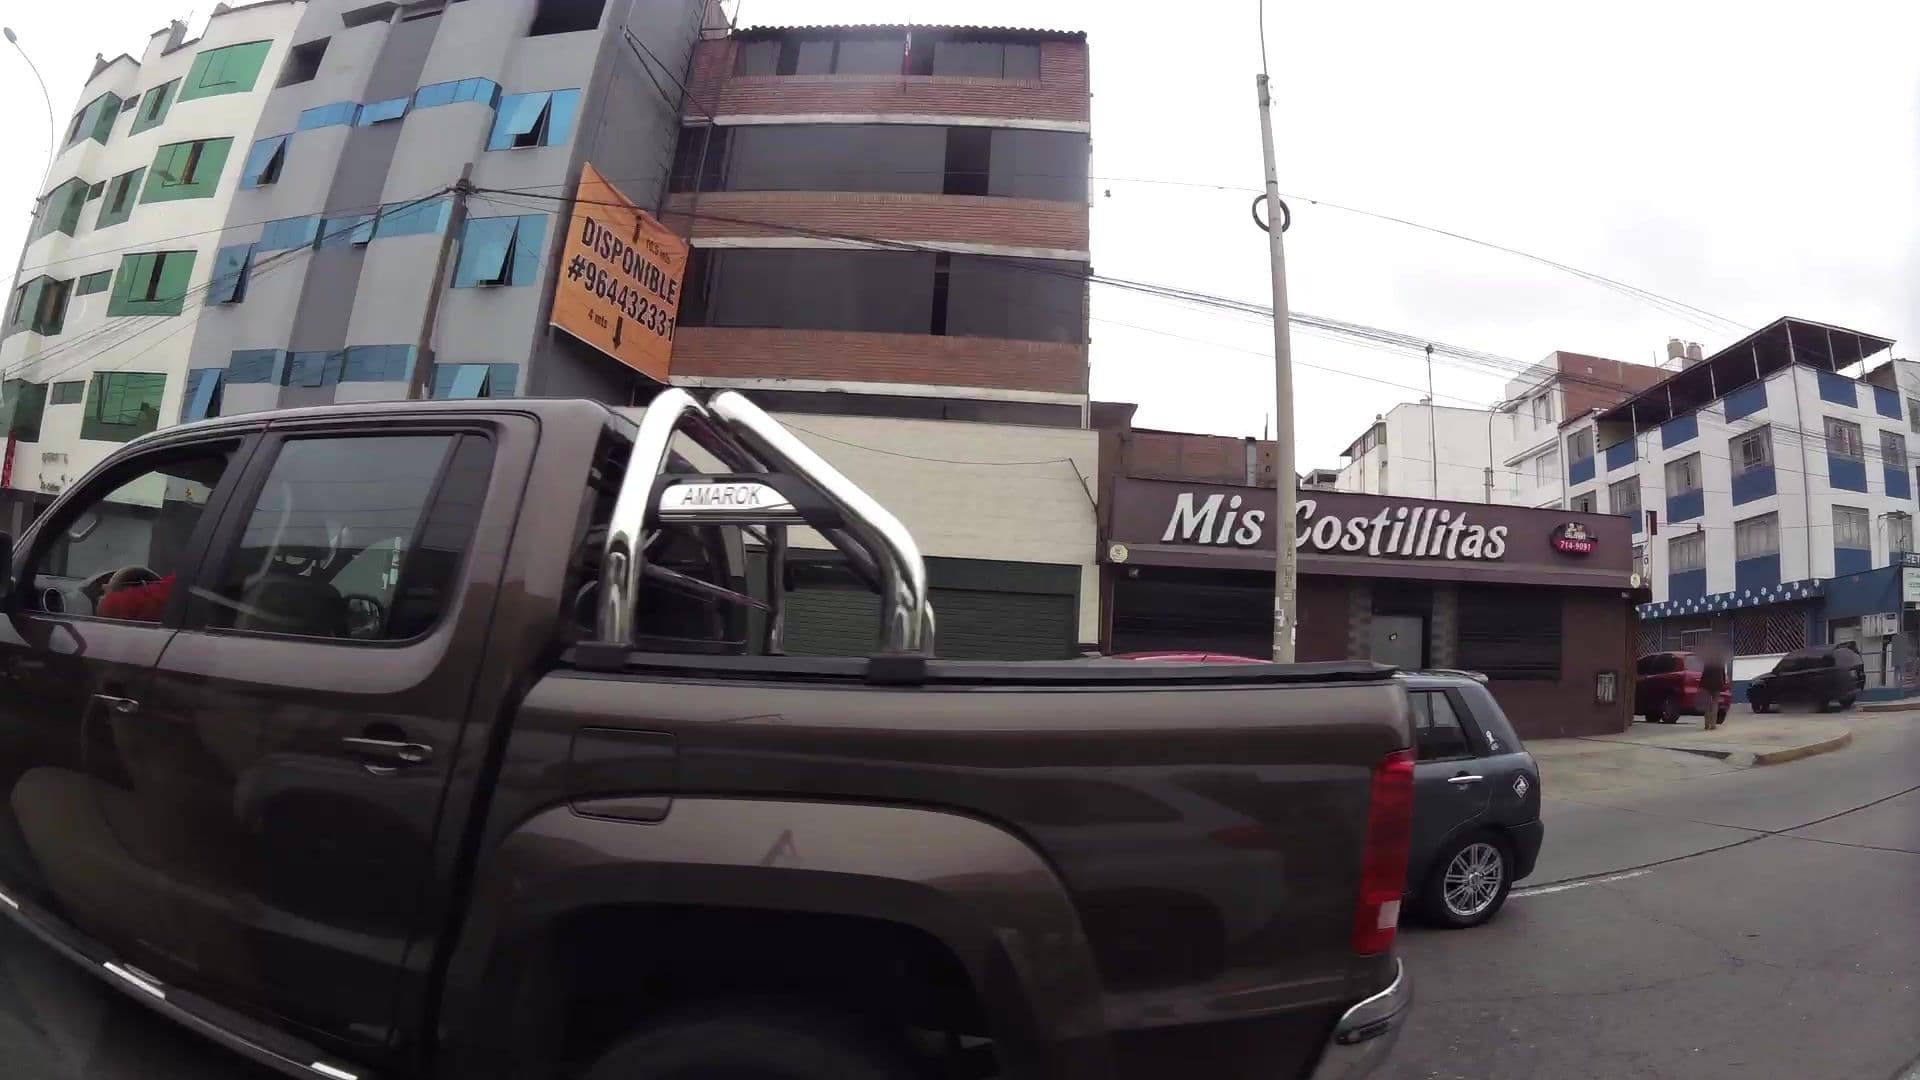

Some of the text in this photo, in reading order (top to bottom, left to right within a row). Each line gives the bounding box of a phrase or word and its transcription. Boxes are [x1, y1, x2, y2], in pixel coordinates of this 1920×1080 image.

[582, 216, 677, 305] DISPONIBLE
[568, 254, 675, 342] #964432331
[588, 308, 595, 320] 4
[680, 486, 761, 506] AMAROK
[1161, 492, 1508, 560] Mis Costillitas
